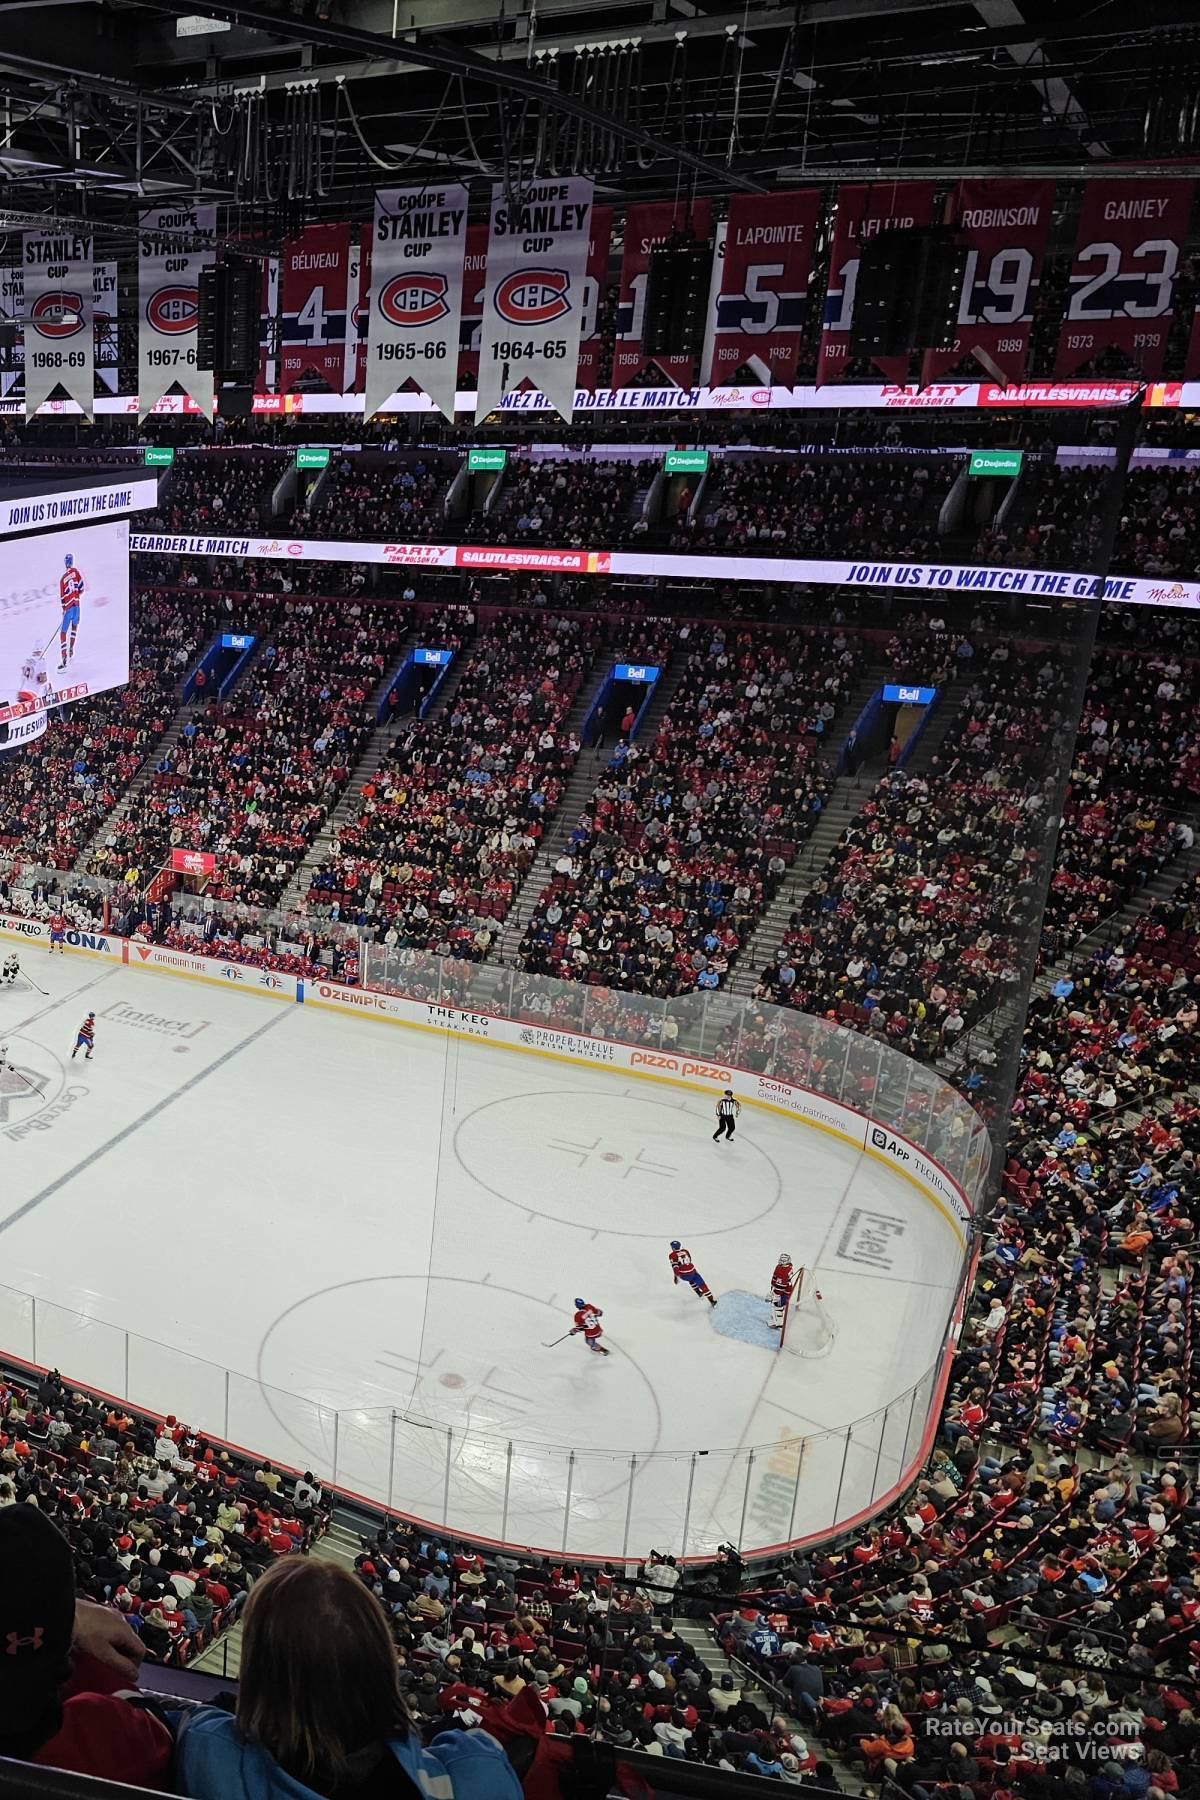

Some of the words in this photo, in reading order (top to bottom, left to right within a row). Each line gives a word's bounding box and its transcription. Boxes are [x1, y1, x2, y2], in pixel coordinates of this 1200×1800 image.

[398, 192, 446, 210] COUPE
[1104, 199, 1169, 220] GAINEY
[158, 213, 198, 228] COUPE
[377, 210, 464, 240] STANLEY
[494, 204, 589, 236] STANLEY
[962, 207, 1040, 228] ROBINSON
[736, 225, 804, 246] LAPOINTE
[26, 238, 91, 264] STANLEY
[403, 243, 432, 258] CUP
[522, 238, 554, 254] CUP
[165, 258, 189, 272] CUP
[292, 250, 339, 270] BÉLIVEAU
[47, 266, 69, 278] CUP
[1068, 240, 1180, 320] 23
[956, 248, 1033, 325] 19
[740, 264, 784, 334] 5
[298, 286, 328, 346] 4
[491, 340, 566, 360] 1964-65
[997, 340, 1022, 352] 1989
[1068, 335, 1094, 348] 1973
[376, 342, 446, 360] 1965-66
[718, 348, 739, 360] 1968
[825, 345, 846, 357] 1971
[32, 352, 86, 368] 1968-69
[284, 358, 301, 368] 1950
[324, 357, 340, 368] 1971
[618, 354, 639, 366] 1966
[620, 392, 640, 406] LE
[642, 390, 700, 406] MATCH
[880, 386, 972, 396] PARTY
[886, 398, 914, 406] ZONE
[984, 460, 1017, 468] Desjardins
[8, 508, 30, 526] JOIN
[32, 504, 44, 520] US
[46, 502, 58, 518] TO
[60, 497, 90, 516] WATCH
[92, 494, 107, 512] THE
[108, 490, 132, 508] GAME
[190, 538, 204, 552] LE
[206, 539, 250, 554] MATCH
[383, 546, 449, 556] PARTY
[462, 552, 581, 568] SALUTLESVRAIS.CA
[846, 566, 893, 583] JOIN
[894, 567, 922, 584] US
[926, 569, 952, 586] TO
[956, 570, 1028, 591] WATCH
[1030, 574, 1070, 594] THE
[1072, 578, 1137, 600] GAME
[1146, 587, 1190, 602] Molson
[231, 636, 244, 646] Bell
[425, 652, 441, 662] Bell
[628, 668, 646, 679] Bell
[898, 688, 919, 700] Bell
[154, 953, 189, 970] CANADIAN
[190, 960, 206, 972] TIRE
[116, 1006, 192, 1032] intact
[428, 1006, 455, 1018] THE
[462, 1012, 489, 1026] KEG
[427, 1018, 459, 1030] STEAK
[468, 1027, 489, 1037] BAR
[536, 1040, 564, 1051] IRISH
[570, 1048, 614, 1062] WHISKEY
[630, 1051, 679, 1072] pizza
[681, 1062, 732, 1083] pizza
[759, 1078, 792, 1096] Scotia
[758, 1089, 790, 1108] Gestion
[790, 1100, 802, 1111] de
[888, 1140, 910, 1161] App
